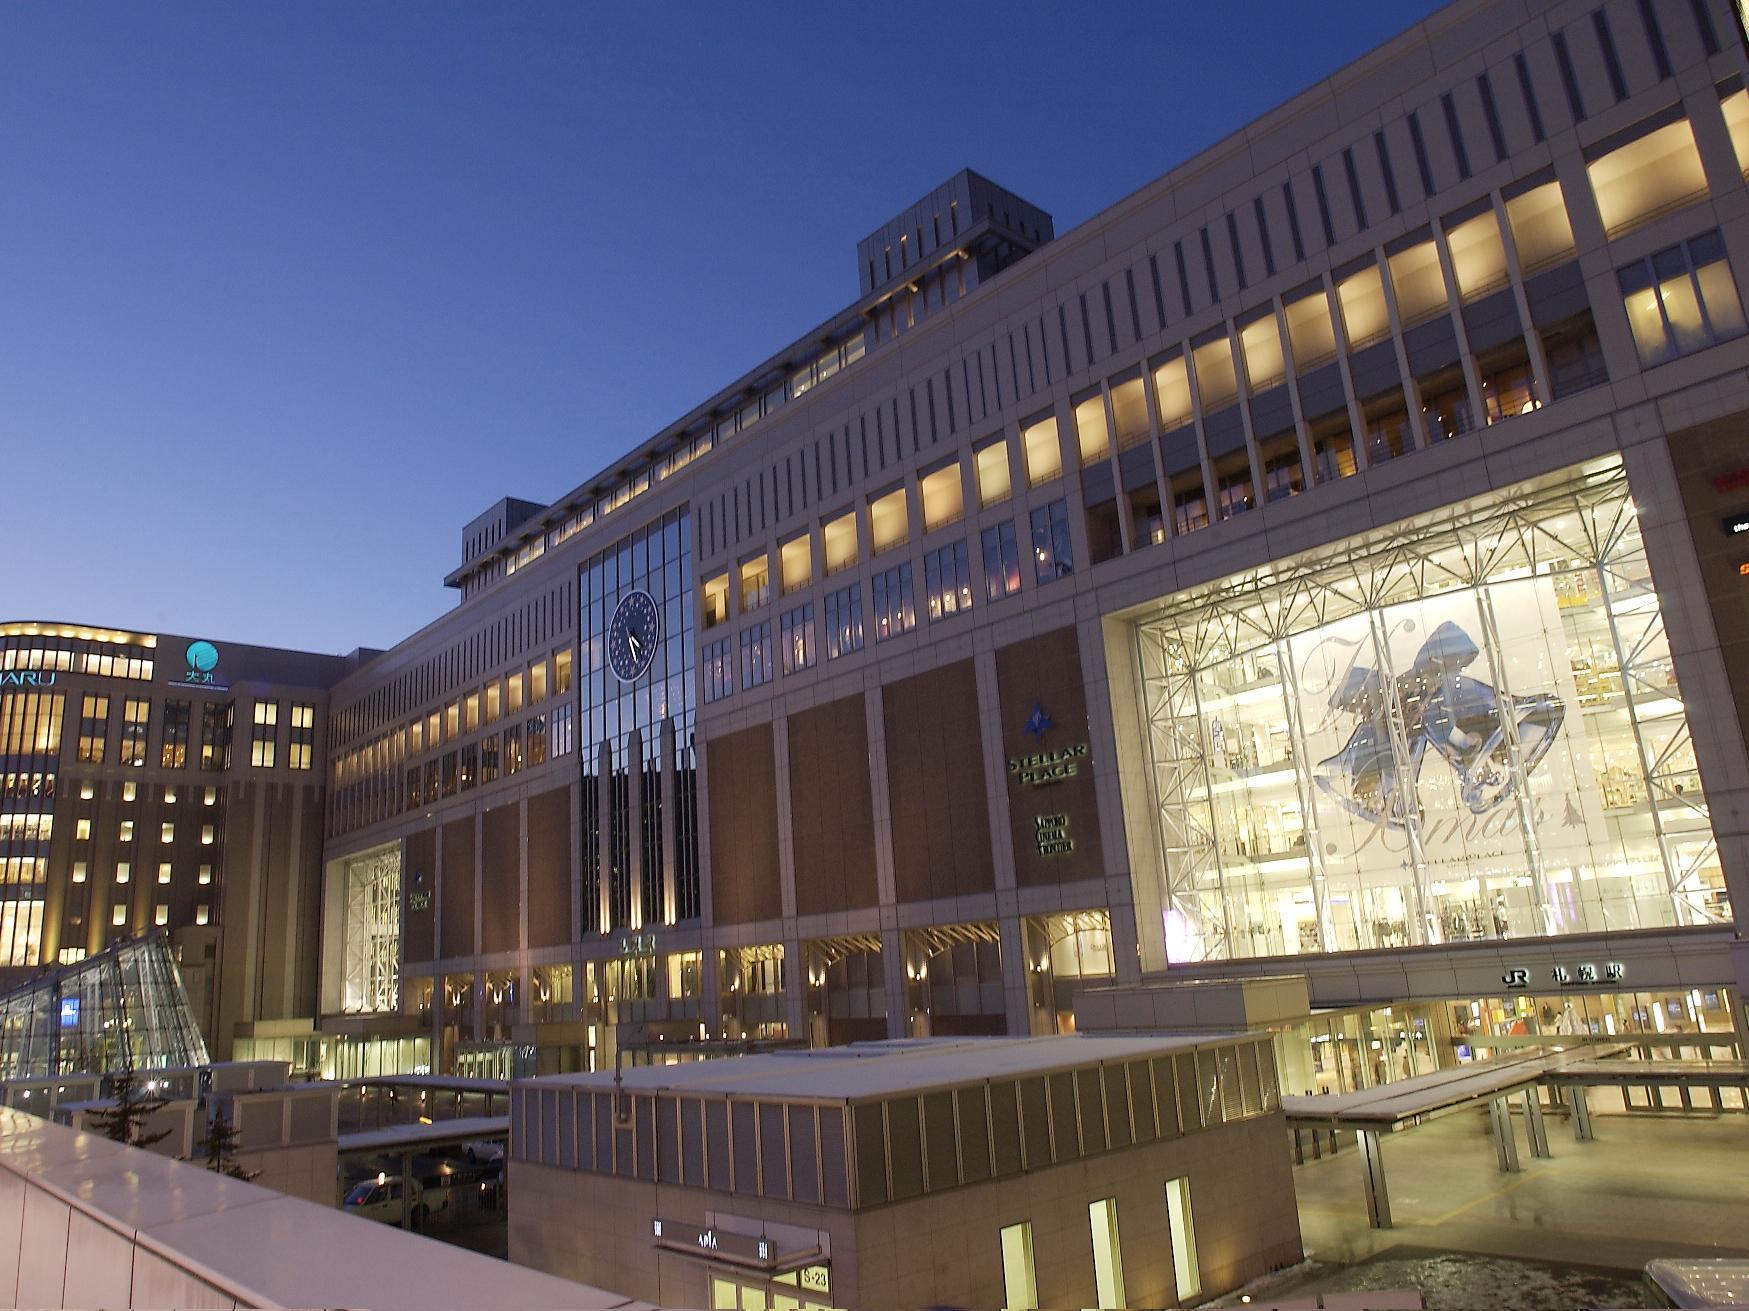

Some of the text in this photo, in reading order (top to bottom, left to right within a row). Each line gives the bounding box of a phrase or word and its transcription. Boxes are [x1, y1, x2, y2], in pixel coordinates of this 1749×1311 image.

[0, 671, 56, 686] ARU
[185, 671, 215, 683] 大丸
[1008, 744, 1087, 772] STELLAR
[1019, 763, 1078, 784] PLACE
[1502, 963, 1624, 984] JR 札幌駅
